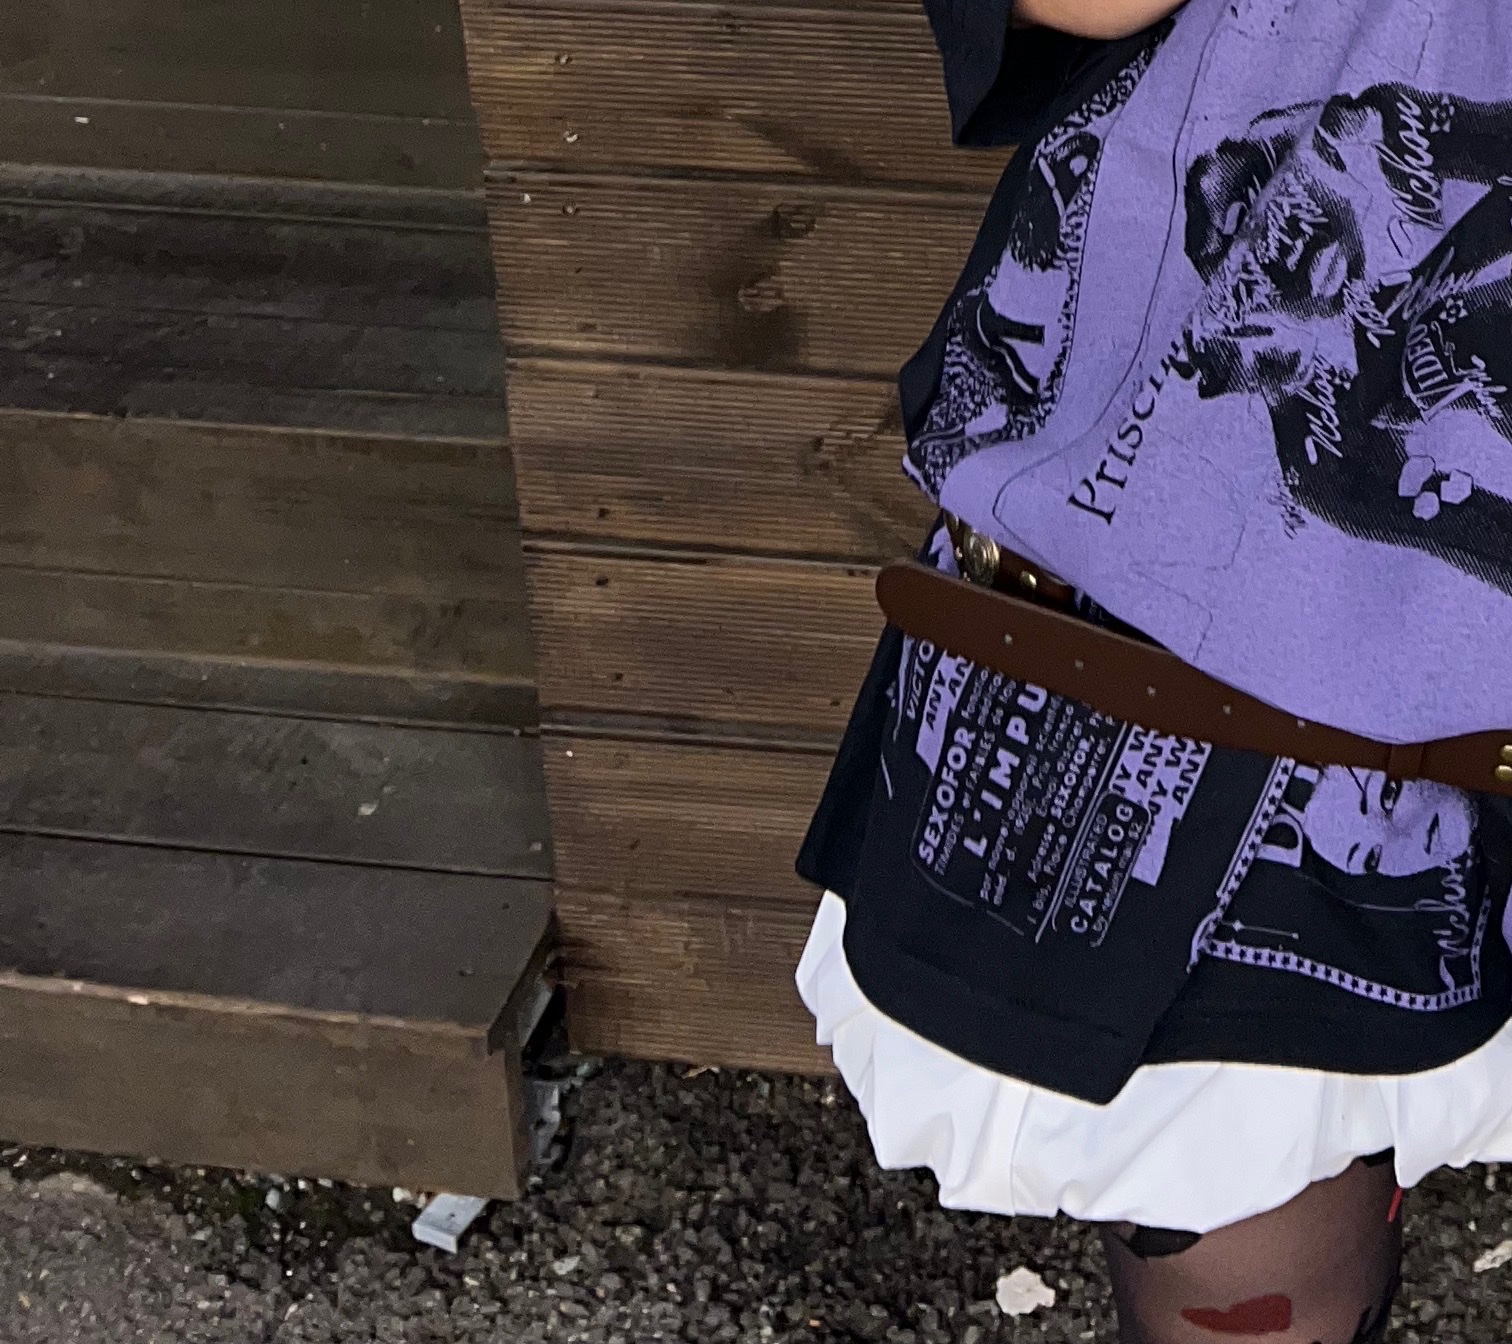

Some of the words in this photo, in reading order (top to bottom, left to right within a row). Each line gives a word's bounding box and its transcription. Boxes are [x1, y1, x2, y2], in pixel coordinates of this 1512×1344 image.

[906, 640, 934, 719] VICTO
[919, 727, 976, 864] SEXOFOR
[963, 683, 1047, 857] L'IMPU
[1070, 804, 1133, 932] CATALOG
